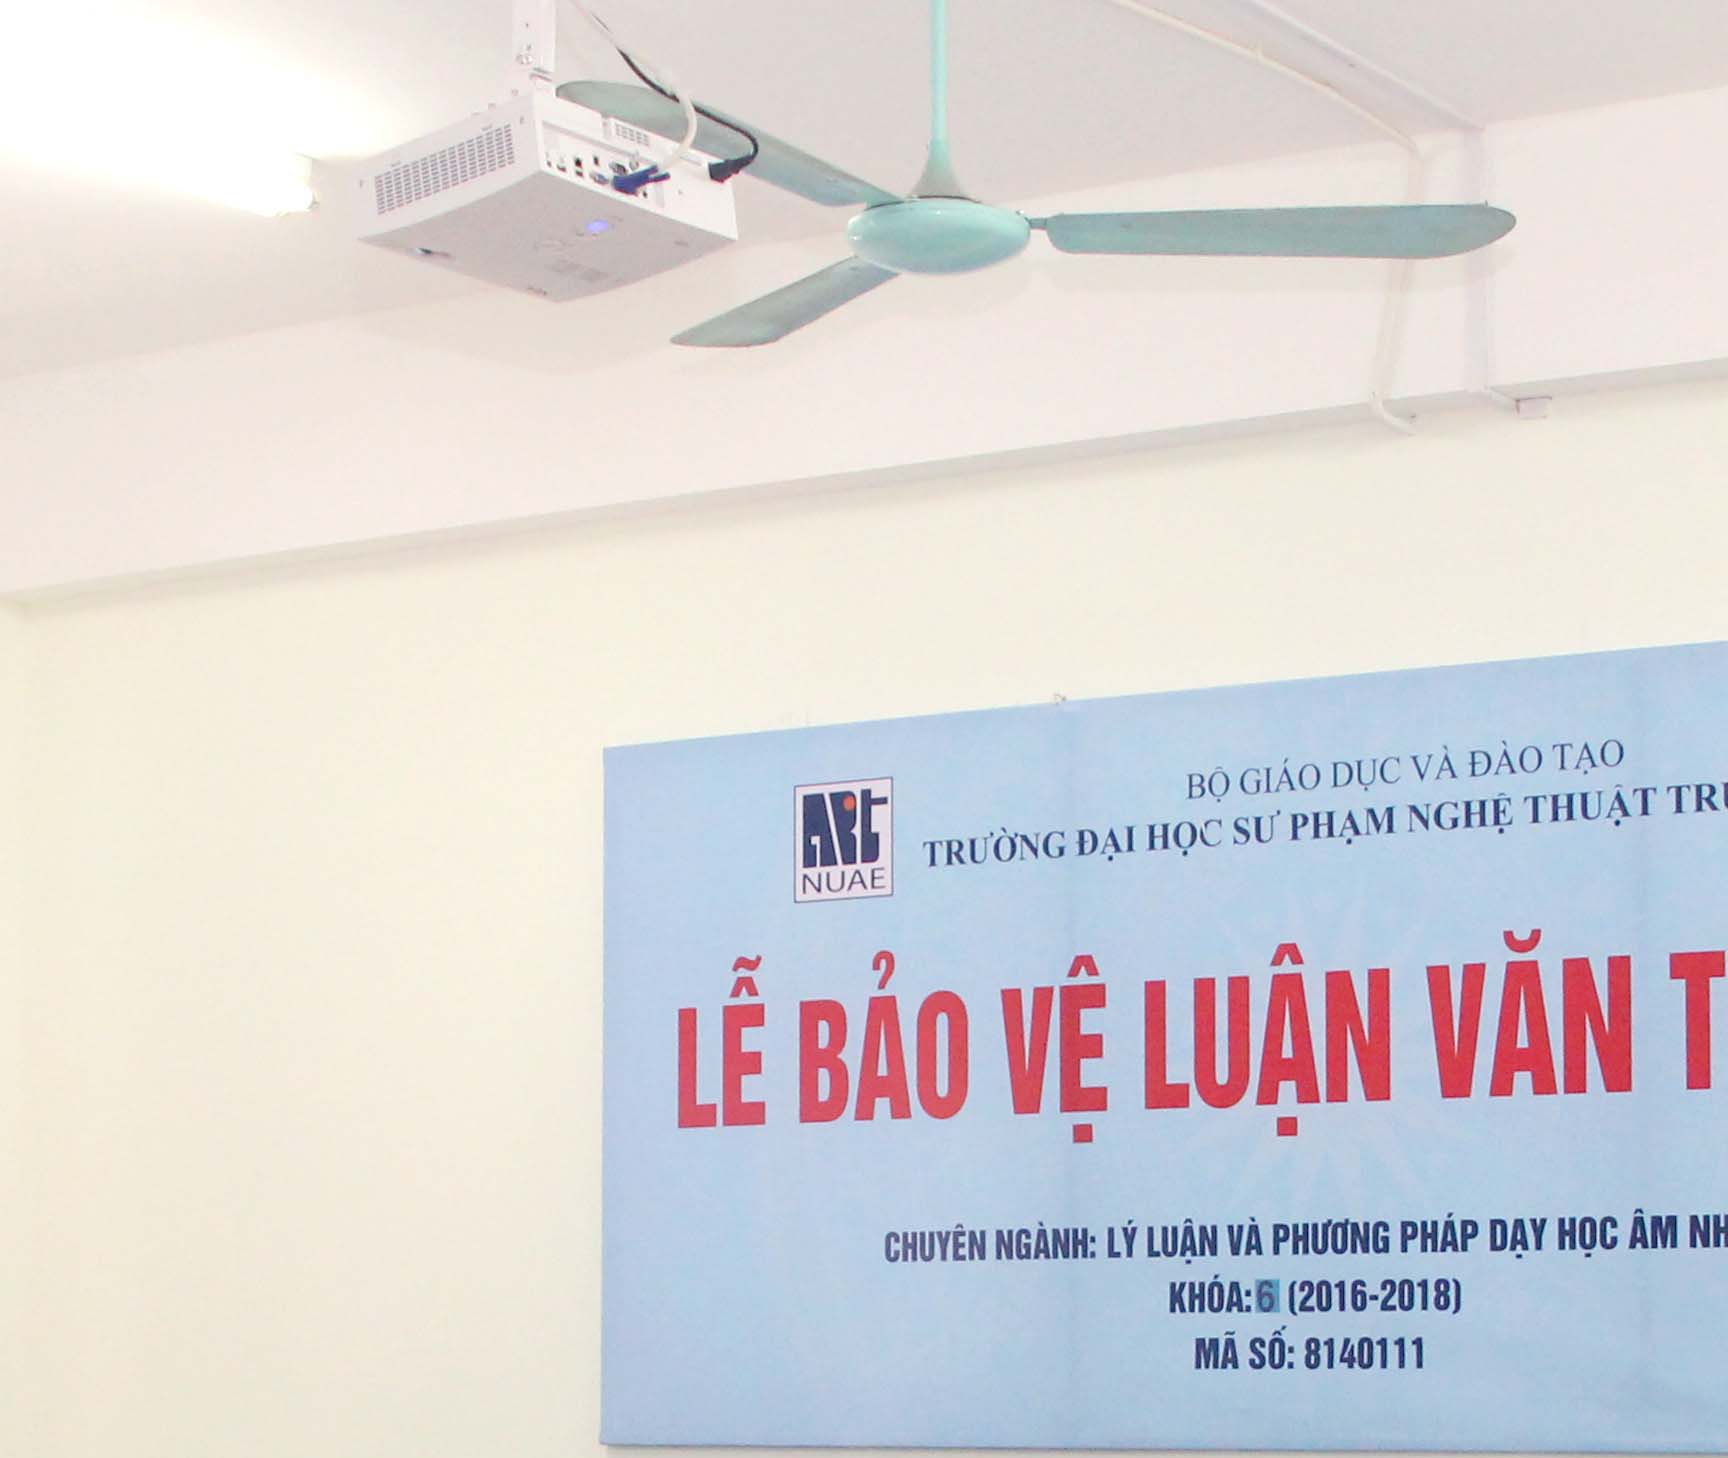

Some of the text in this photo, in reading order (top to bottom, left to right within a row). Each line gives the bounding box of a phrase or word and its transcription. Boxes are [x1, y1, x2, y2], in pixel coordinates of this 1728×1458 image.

[1187, 739, 1625, 802] BỘ GIÁO DỤC VÀ ĐÀO TẠO
[922, 827, 1067, 868] TRƯỜNG
[1075, 825, 1135, 862] ĐẠI
[1147, 819, 1223, 857] HỌC
[1232, 809, 1281, 845] SƯ
[1290, 806, 1396, 846] PHẠM
[1407, 792, 1513, 835] NGHỆ
[1523, 784, 1658, 827] THUẬT
[802, 866, 886, 894] NUAE
[677, 954, 767, 1128] LỄ
[799, 949, 969, 1124] BẢO
[1000, 954, 1109, 1144] VỆ
[1144, 942, 1393, 1137] LUẬN
[1426, 928, 1633, 1099] VĂN
[884, 1223, 987, 1263] CHUYÊN
[995, 1221, 1097, 1261] NGÀNH:
[1107, 1219, 1138, 1259] LÝ
[1146, 1217, 1219, 1265] LUẬN
[1227, 1216, 1264, 1257] VÀ
[1272, 1217, 1391, 1256] PHƯƠNG
[1399, 1212, 1480, 1254] PHÁP
[1488, 1217, 1548, 1259] DẠY
[1557, 1215, 1619, 1260] HỌC
[1628, 1207, 1679, 1250] ÂM
[1288, 1277, 1462, 1317] (2016-2018)
[1194, 1325, 1424, 1371] MÃ SỐ: 8140111
